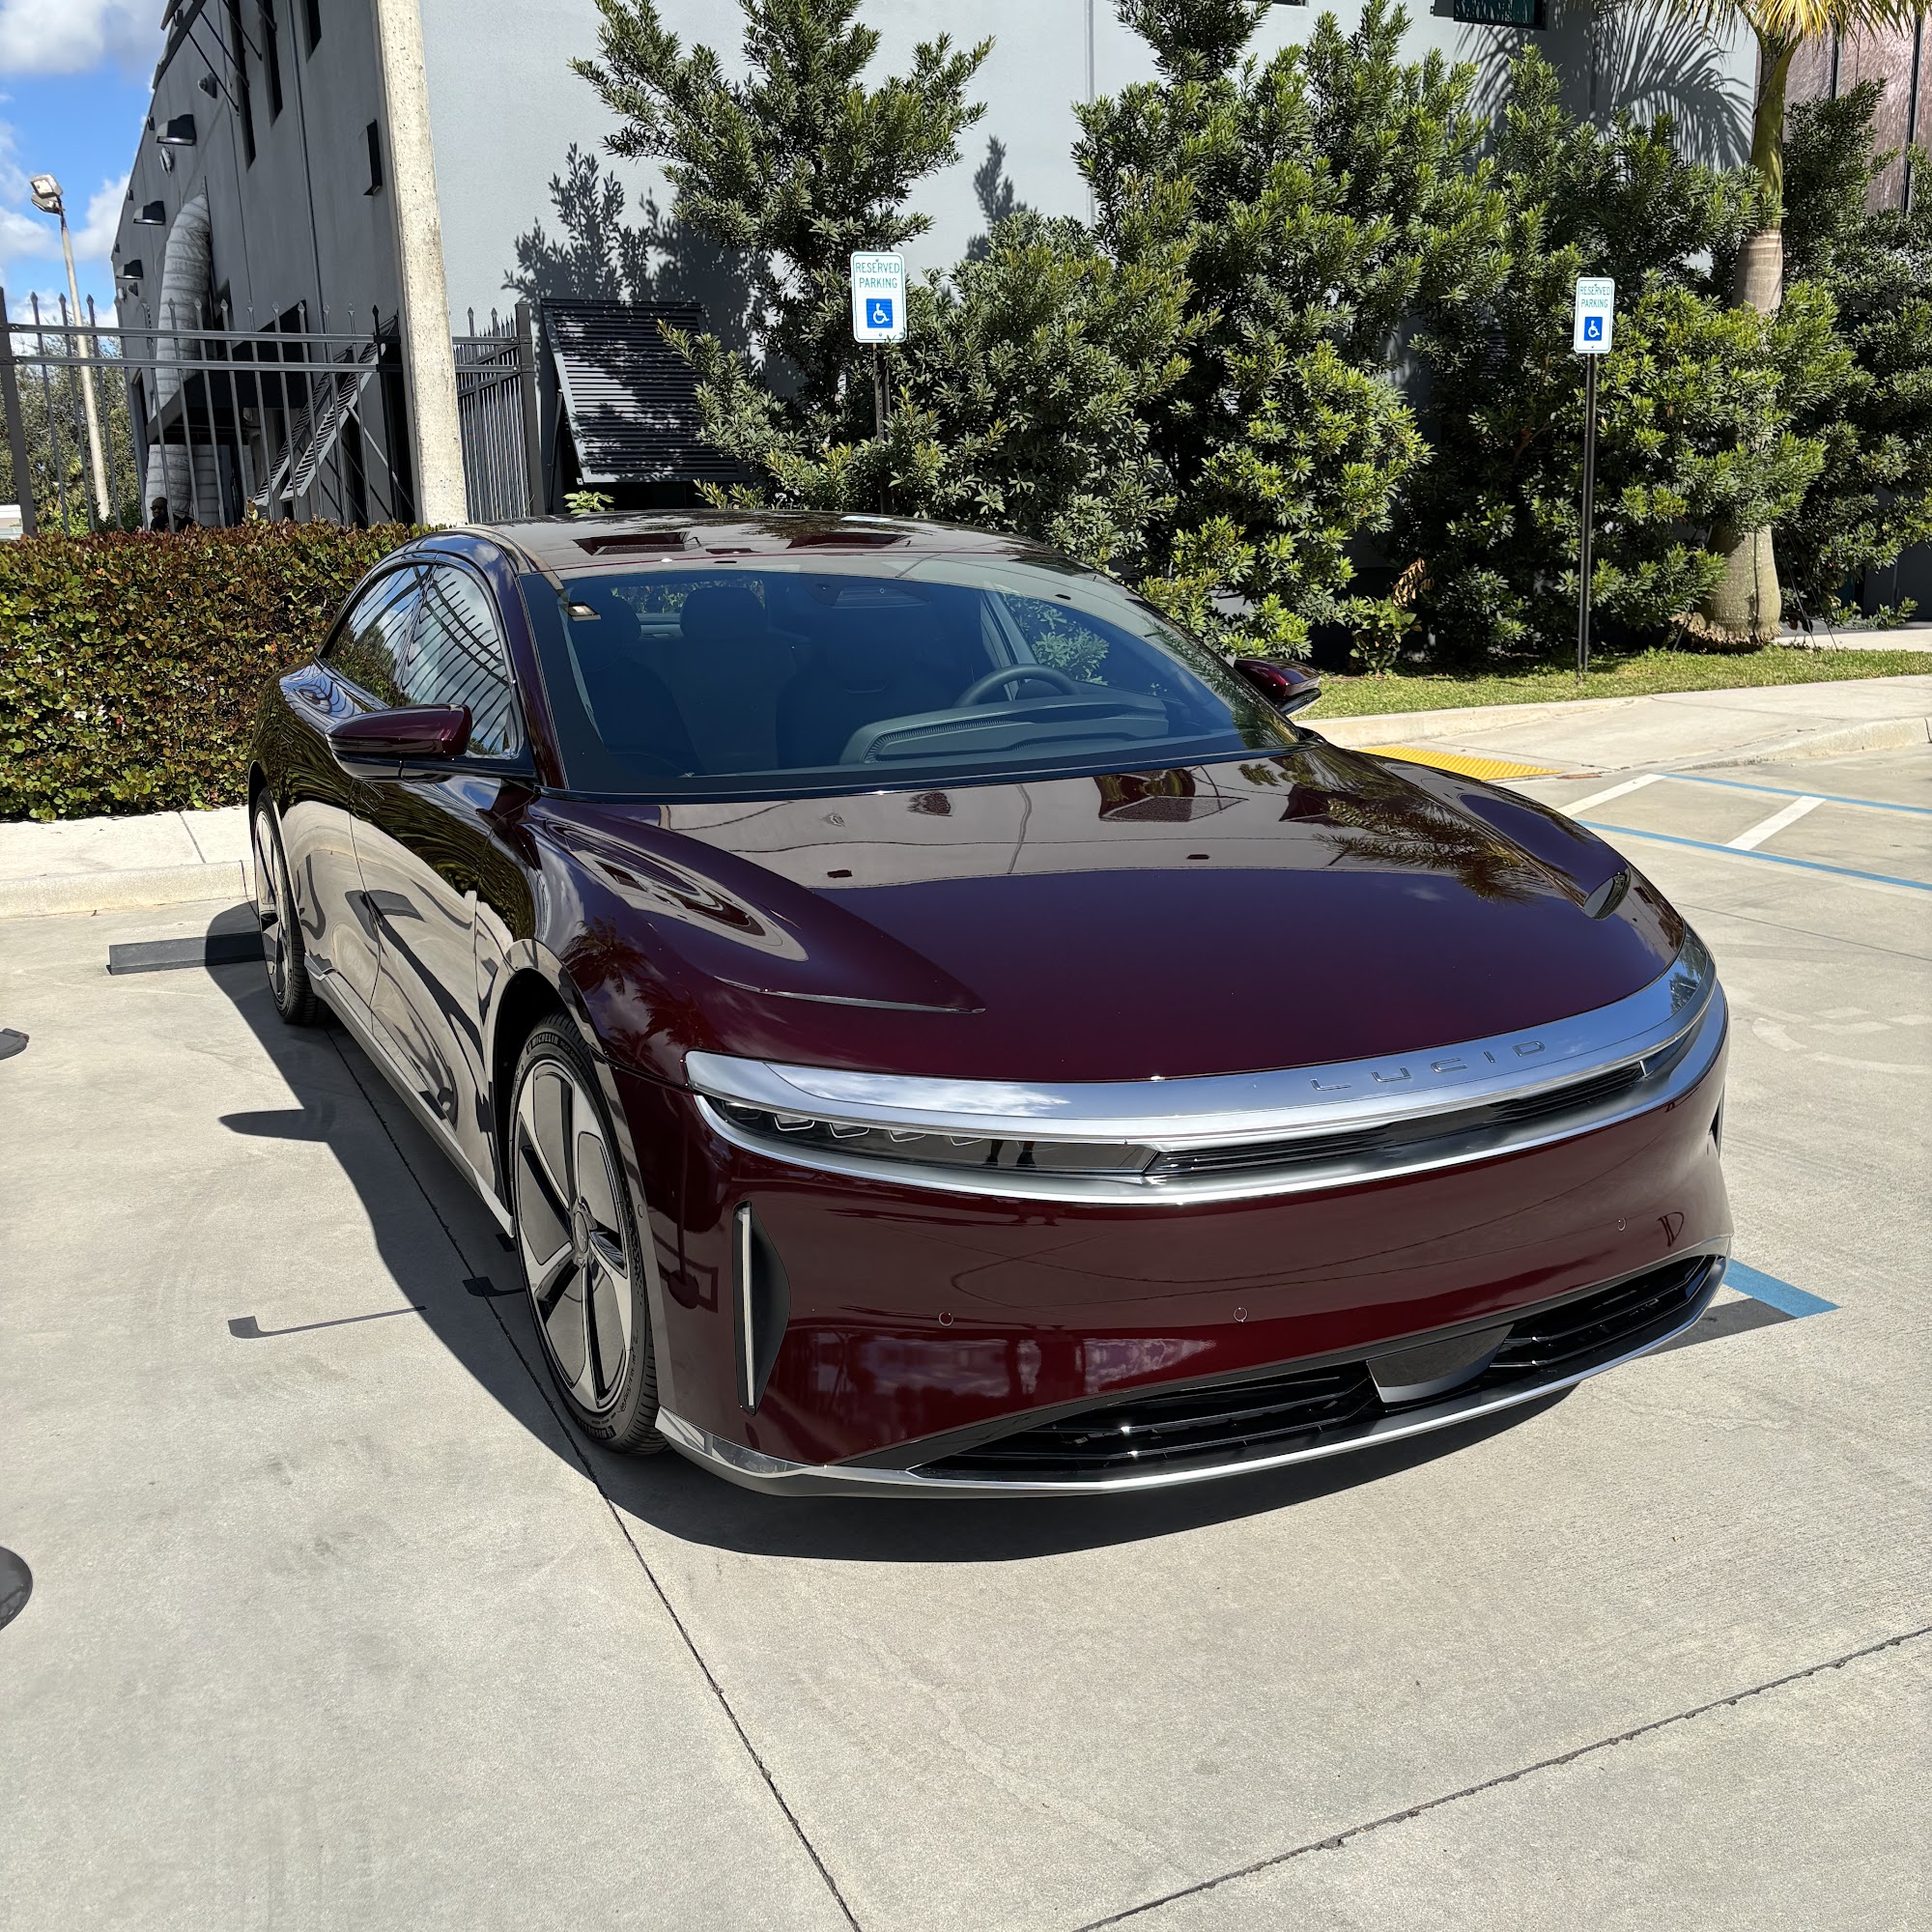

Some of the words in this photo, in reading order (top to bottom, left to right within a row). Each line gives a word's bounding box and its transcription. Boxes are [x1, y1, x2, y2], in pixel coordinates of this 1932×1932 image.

[856, 263, 899, 273] RESERVED
[860, 277, 897, 289] PARKING
[1579, 286, 1610, 296] RESERVED
[1581, 298, 1608, 308] PARKING
[1310, 1040, 1546, 1092] LUCID
